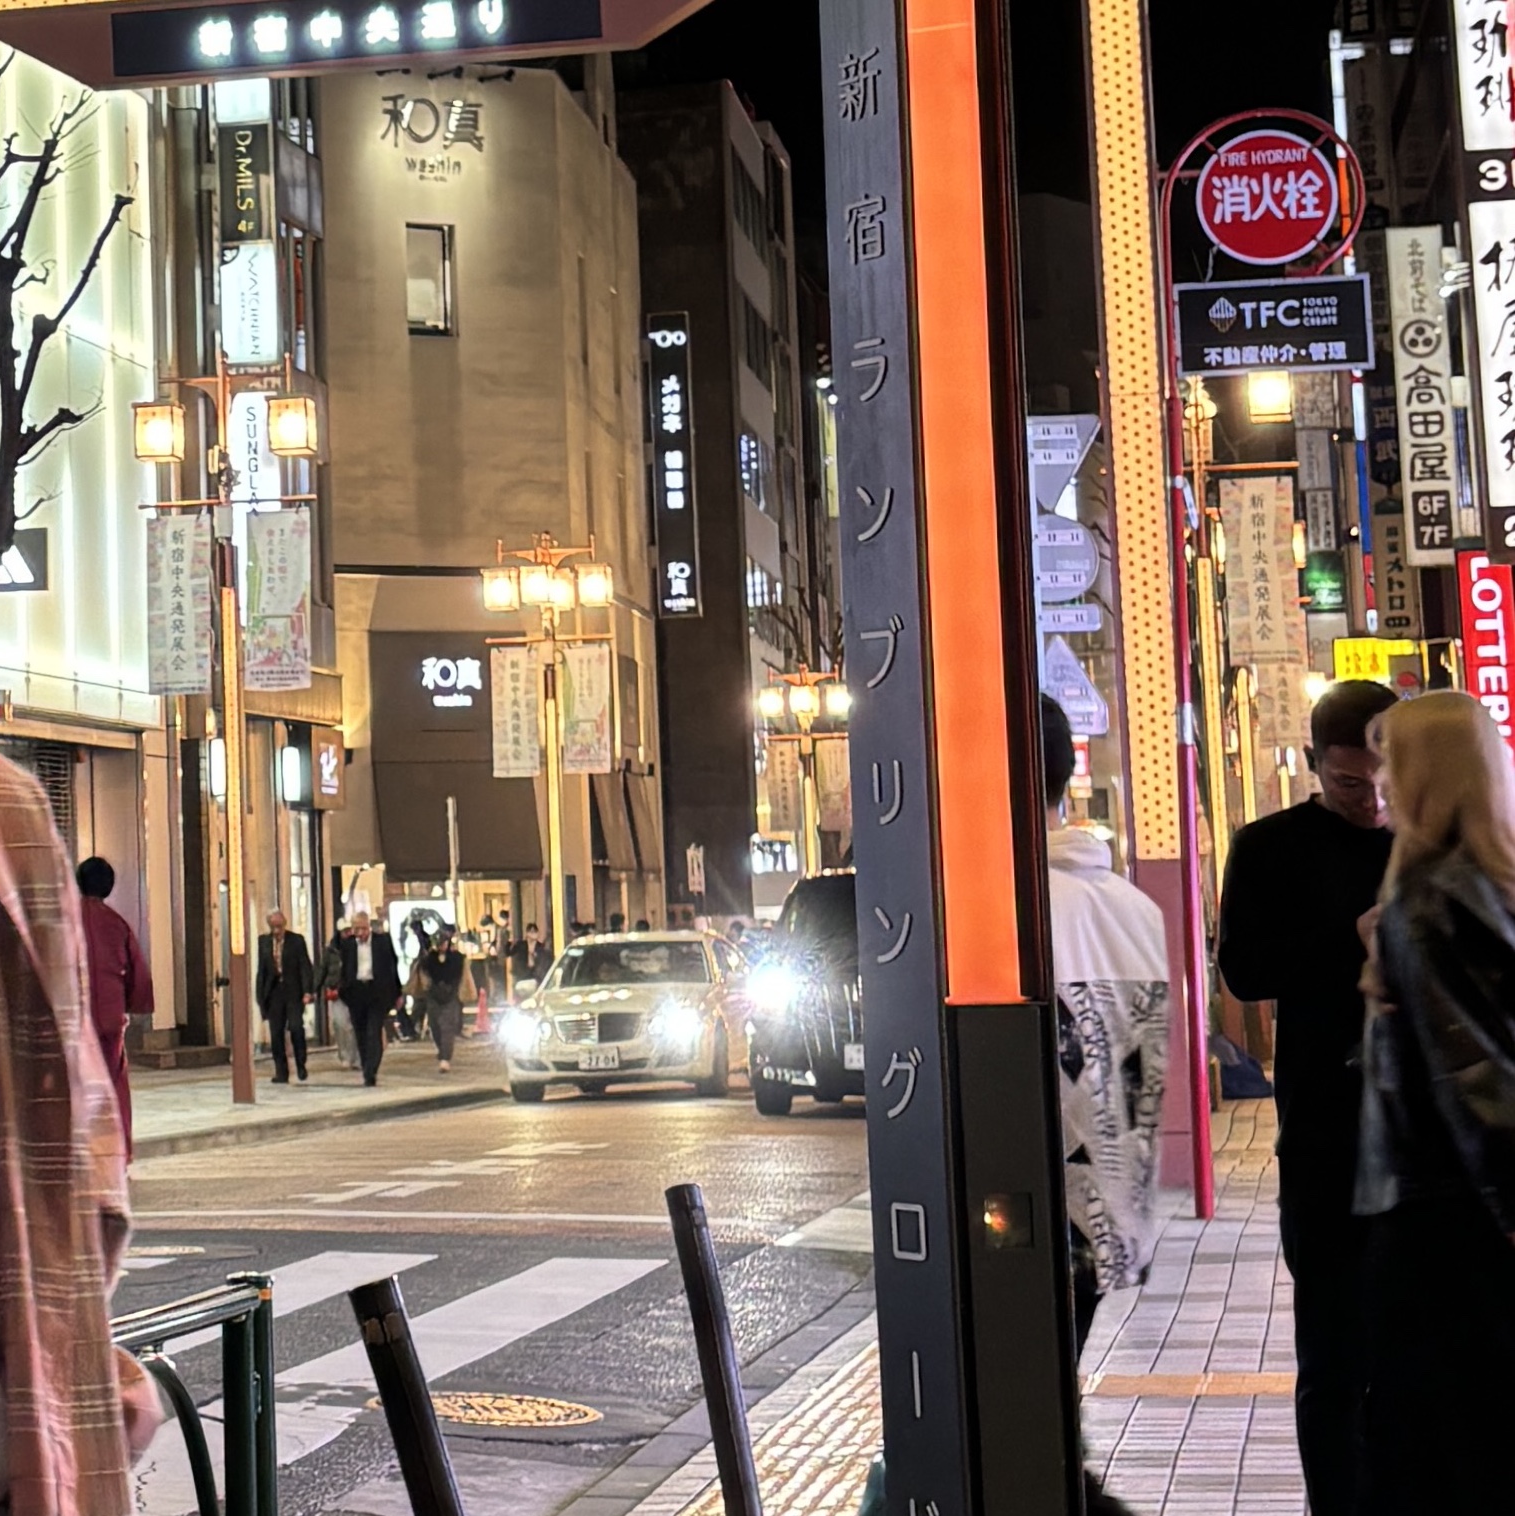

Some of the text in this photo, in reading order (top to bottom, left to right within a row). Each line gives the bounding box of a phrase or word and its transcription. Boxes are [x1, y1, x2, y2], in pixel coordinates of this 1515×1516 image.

[381, 94, 484, 152] 和真
[235, 130, 255, 211] Dr.MILS
[1220, 147, 1308, 168] FIRE HYDRANT
[1478, 158, 1515, 191] 3
[1211, 169, 1324, 225] 消火栓
[1239, 299, 1301, 330] TFC
[1302, 296, 1338, 306] TOKYO
[1403, 363, 1451, 482] 高田屋
[1417, 495, 1447, 516] 6F
[1419, 525, 1449, 546] 7F
[1250, 493, 1275, 641] 新宿中央通発展会
[170, 528, 187, 671] 新宿中央通発展会
